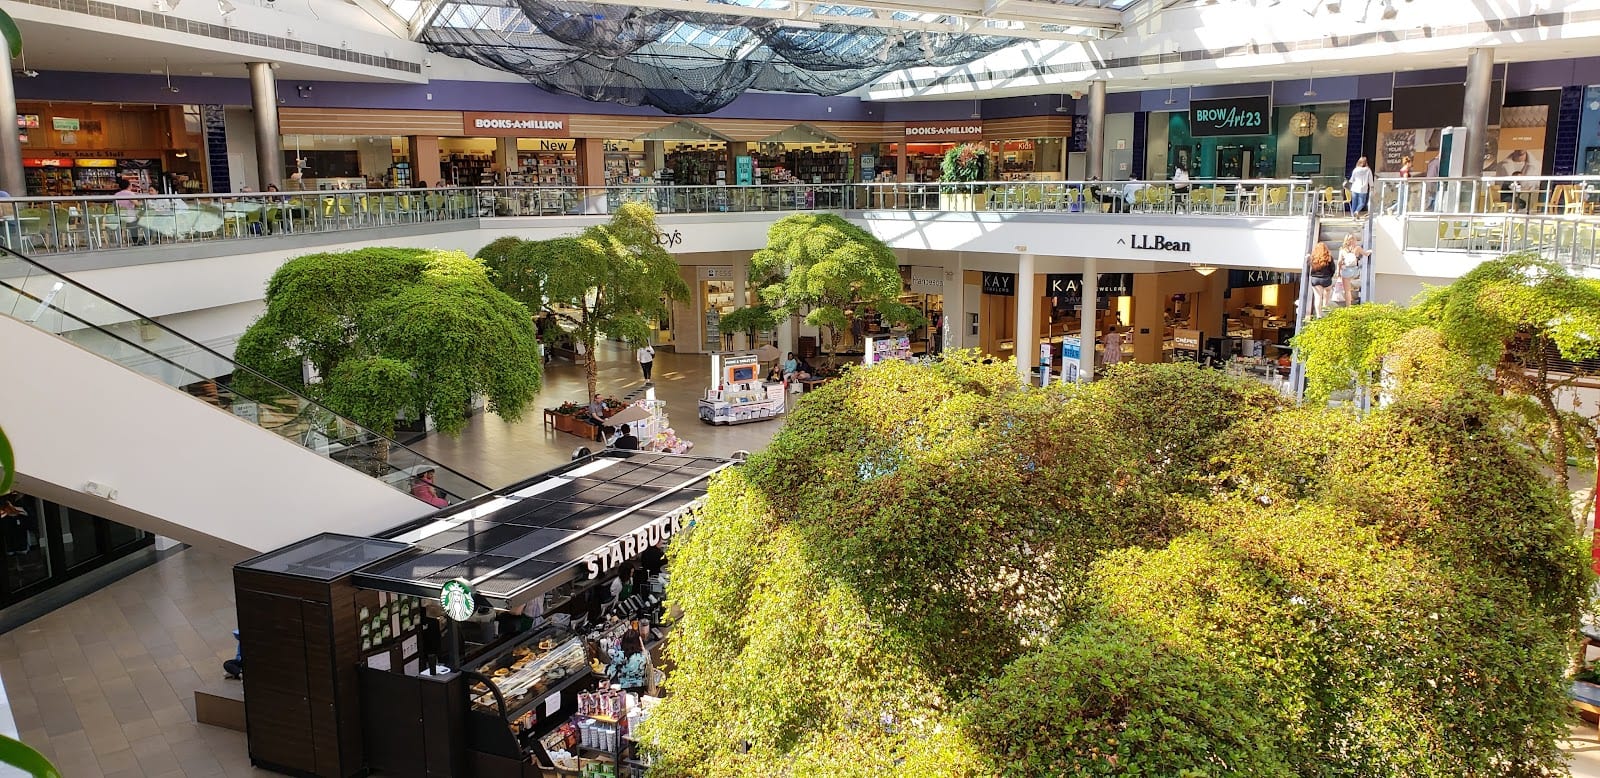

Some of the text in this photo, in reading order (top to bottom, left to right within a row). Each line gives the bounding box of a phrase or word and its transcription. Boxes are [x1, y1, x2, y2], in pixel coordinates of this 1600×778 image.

[1196, 106, 1261, 128] BROW Art 23
[540, 140, 568, 151] New
[1018, 142, 1032, 150] Kids
[652, 229, 682, 248] acy's
[1131, 234, 1191, 252] L.L.Bean
[984, 275, 1010, 287] KAY
[1248, 270, 1270, 282] KAY
[584, 512, 682, 580] STARBUCK
